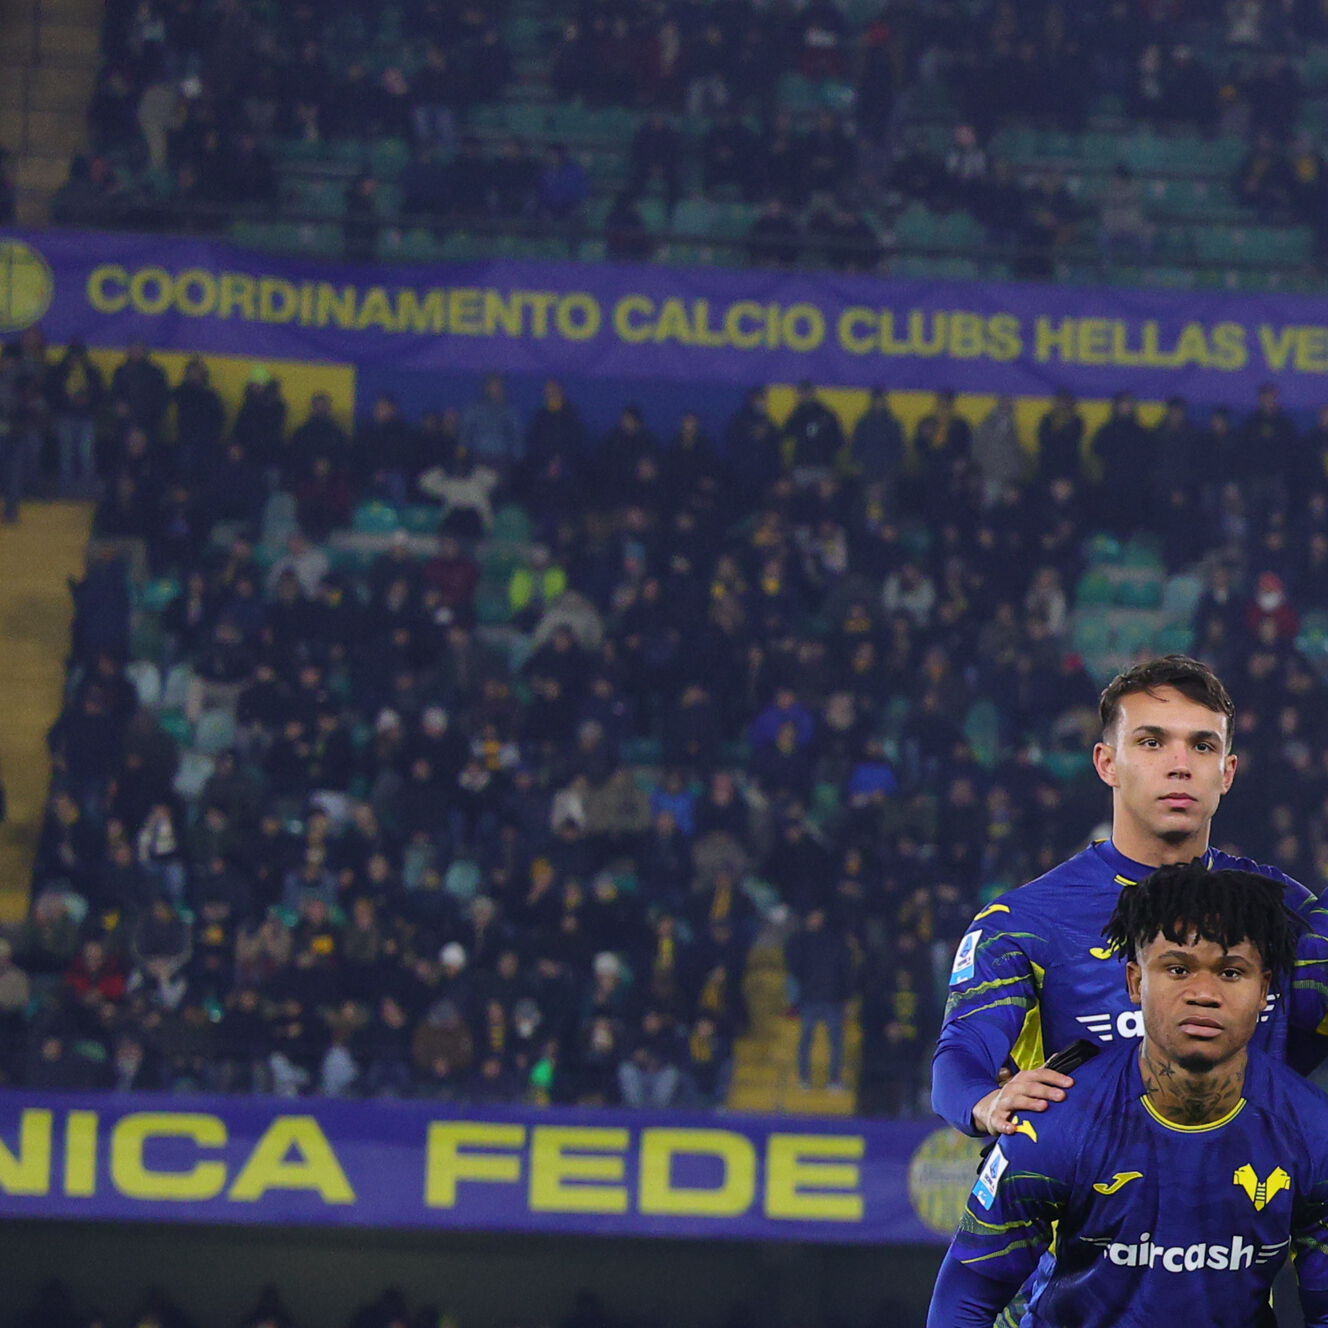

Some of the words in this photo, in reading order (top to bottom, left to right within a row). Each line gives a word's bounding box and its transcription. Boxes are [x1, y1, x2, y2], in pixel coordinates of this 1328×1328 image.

[86, 265, 601, 339] COORDINAMENTO
[614, 295, 824, 351] CALCIO
[838, 306, 1020, 360] CLUBS
[1034, 317, 1247, 371] HELLAS
[425, 1119, 866, 1222] FEDE
[1109, 1231, 1255, 1273] aircash
